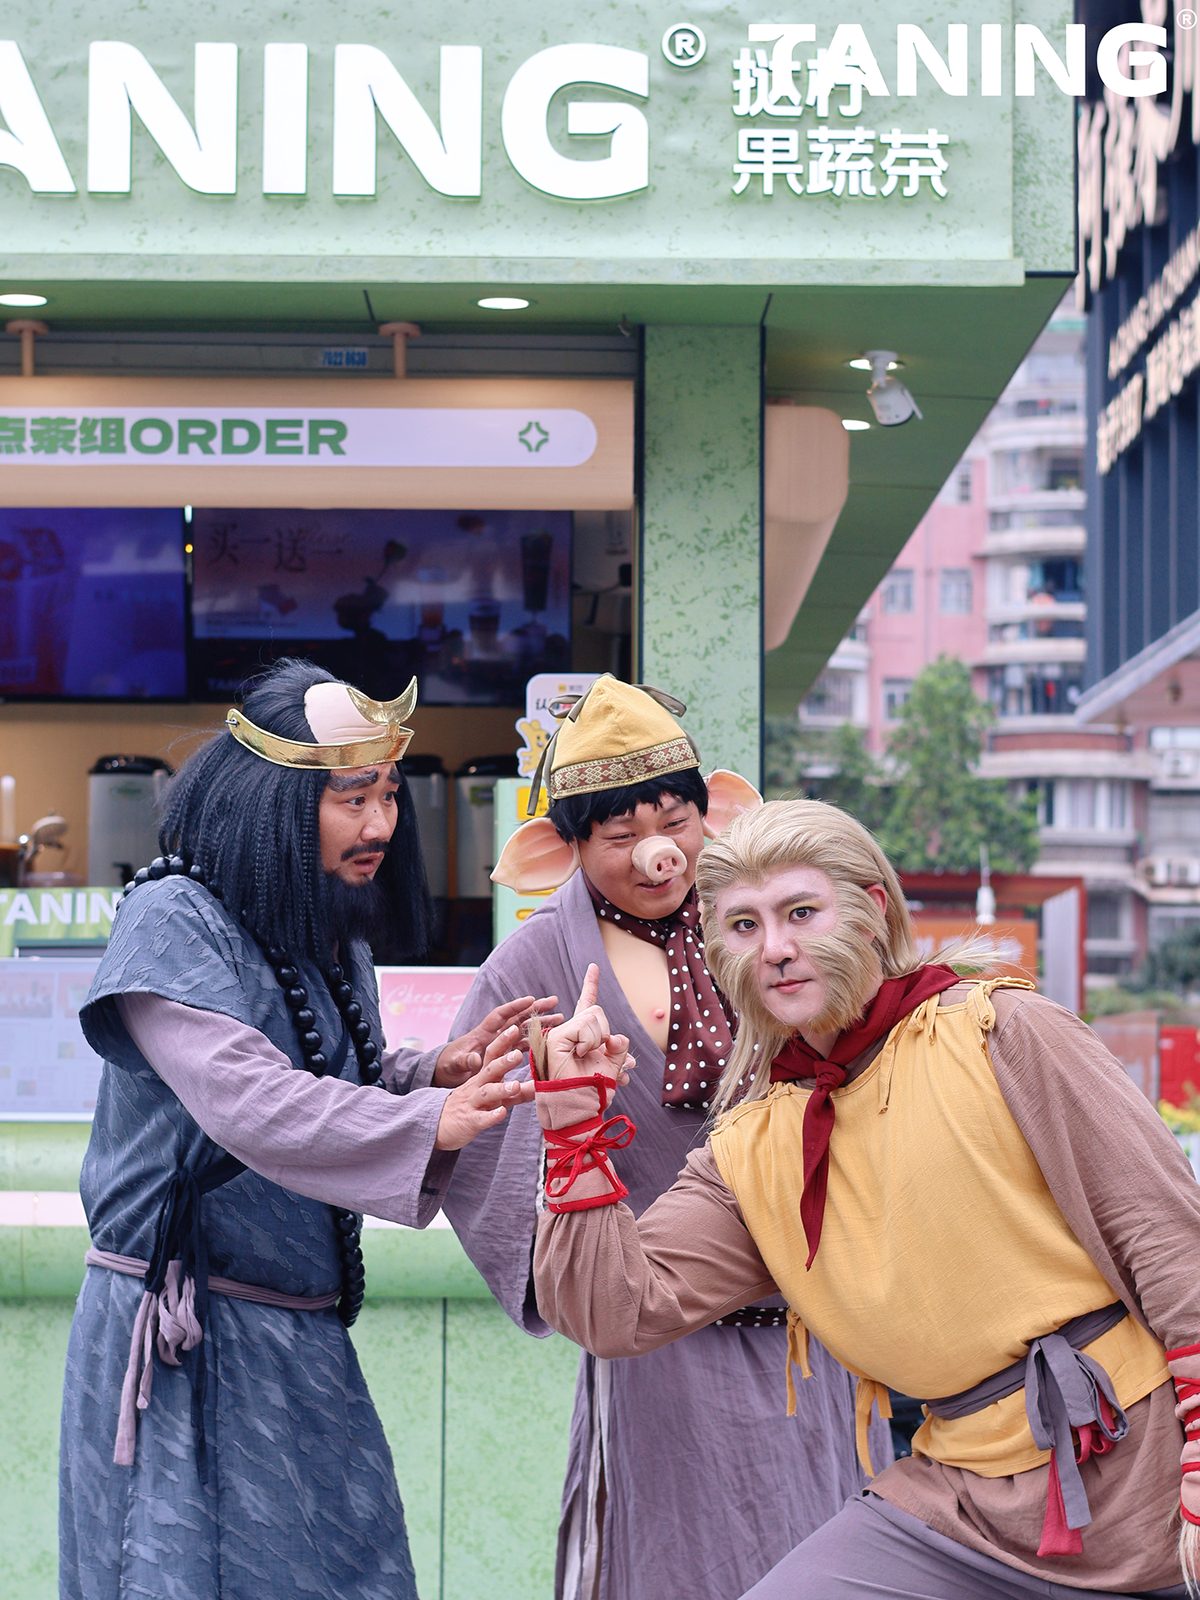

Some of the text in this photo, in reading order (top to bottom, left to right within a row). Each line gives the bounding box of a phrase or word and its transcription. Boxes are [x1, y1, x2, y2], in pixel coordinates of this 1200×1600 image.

[733, 127, 949, 197] 果蔬茶
[0, 892, 122, 925] ANIN
